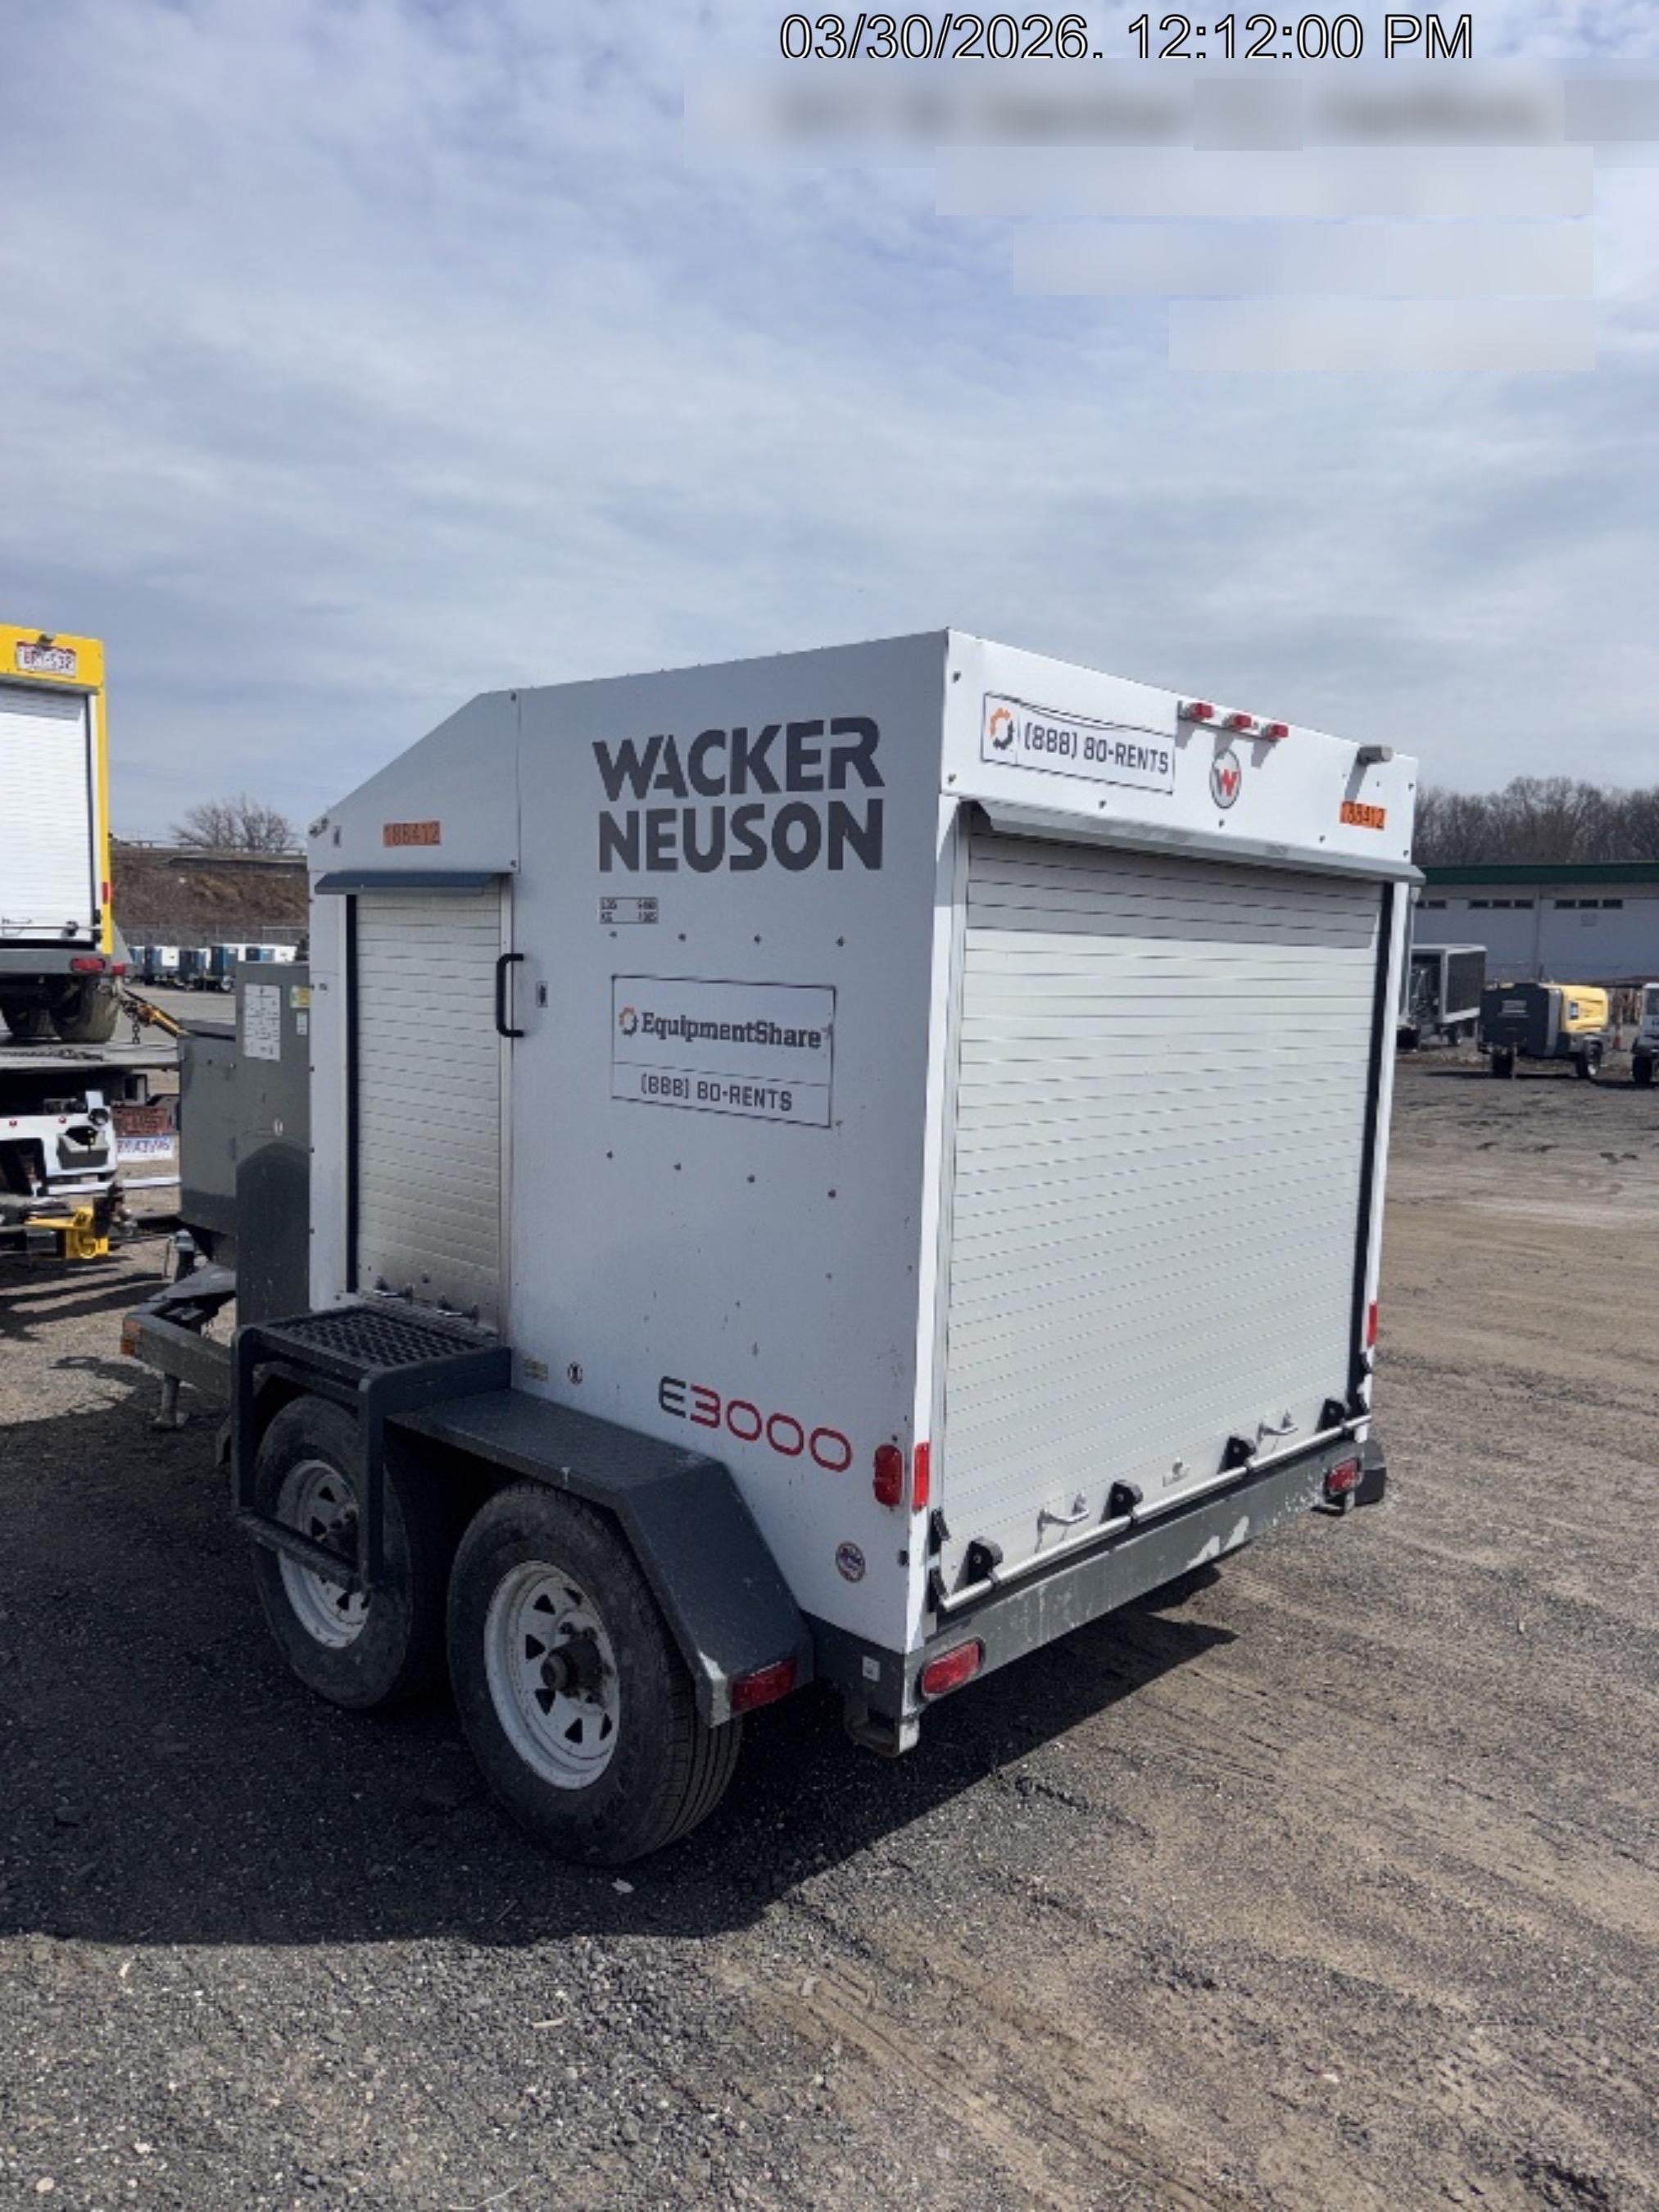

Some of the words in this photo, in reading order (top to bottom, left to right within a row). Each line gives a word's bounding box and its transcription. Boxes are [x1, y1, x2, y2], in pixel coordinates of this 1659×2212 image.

[592, 716, 886, 801] WACKER
[1025, 722, 1077, 759] (888)
[1084, 737, 1169, 774] 80-RENTS
[599, 799, 883, 873] NEUSON
[641, 1012, 822, 1049] EquipmentShare
[641, 1073, 689, 1099] (888)
[697, 1081, 792, 1112] 80-RENTS
[659, 1376, 852, 1473] E3000
